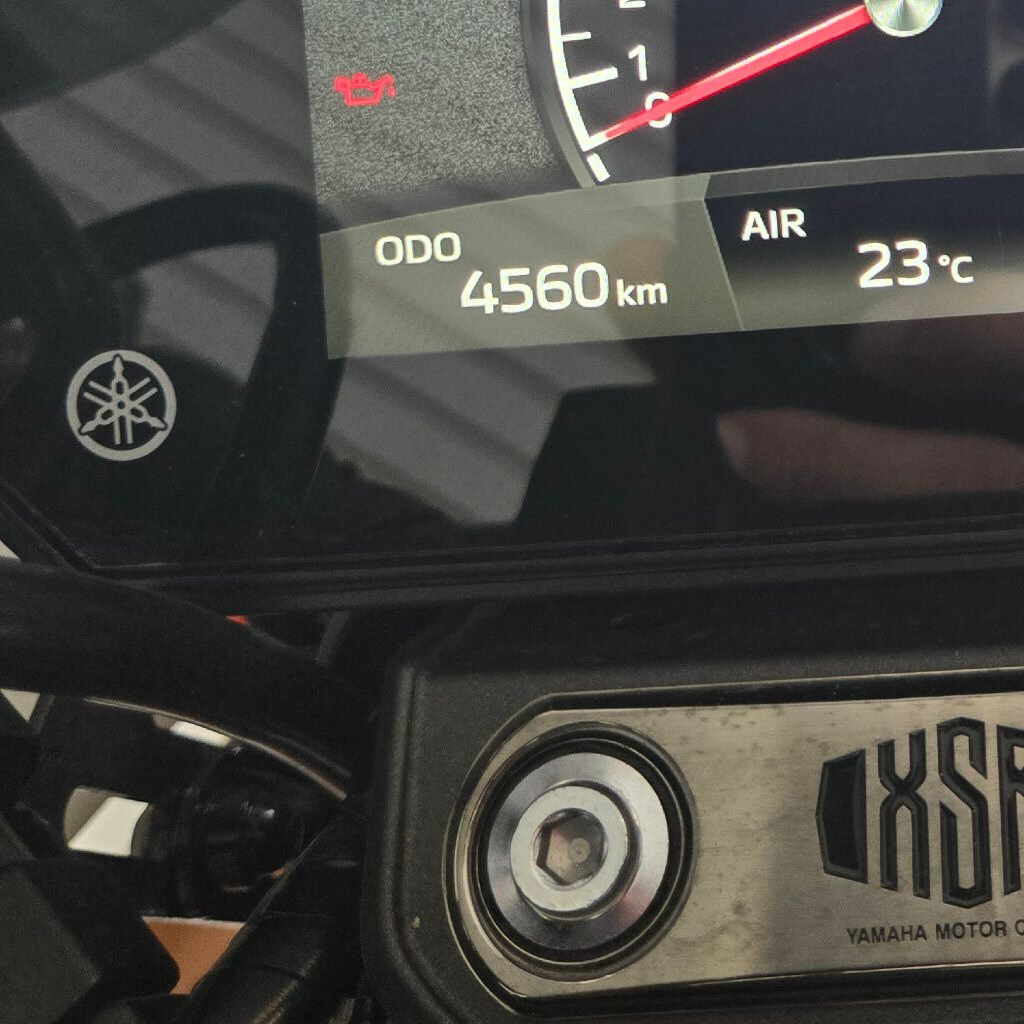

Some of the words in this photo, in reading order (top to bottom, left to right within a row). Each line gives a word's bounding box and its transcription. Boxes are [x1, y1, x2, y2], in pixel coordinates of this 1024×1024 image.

[627, 44, 648, 82] 1
[644, 91, 674, 129] 0
[741, 207, 808, 242] AIR
[374, 231, 462, 267] ODO
[857, 239, 931, 289] 23
[460, 261, 610, 315] 4560
[616, 278, 669, 308] km
[847, 924, 928, 945] YAMAHA
[935, 919, 1008, 940] MOTOR
